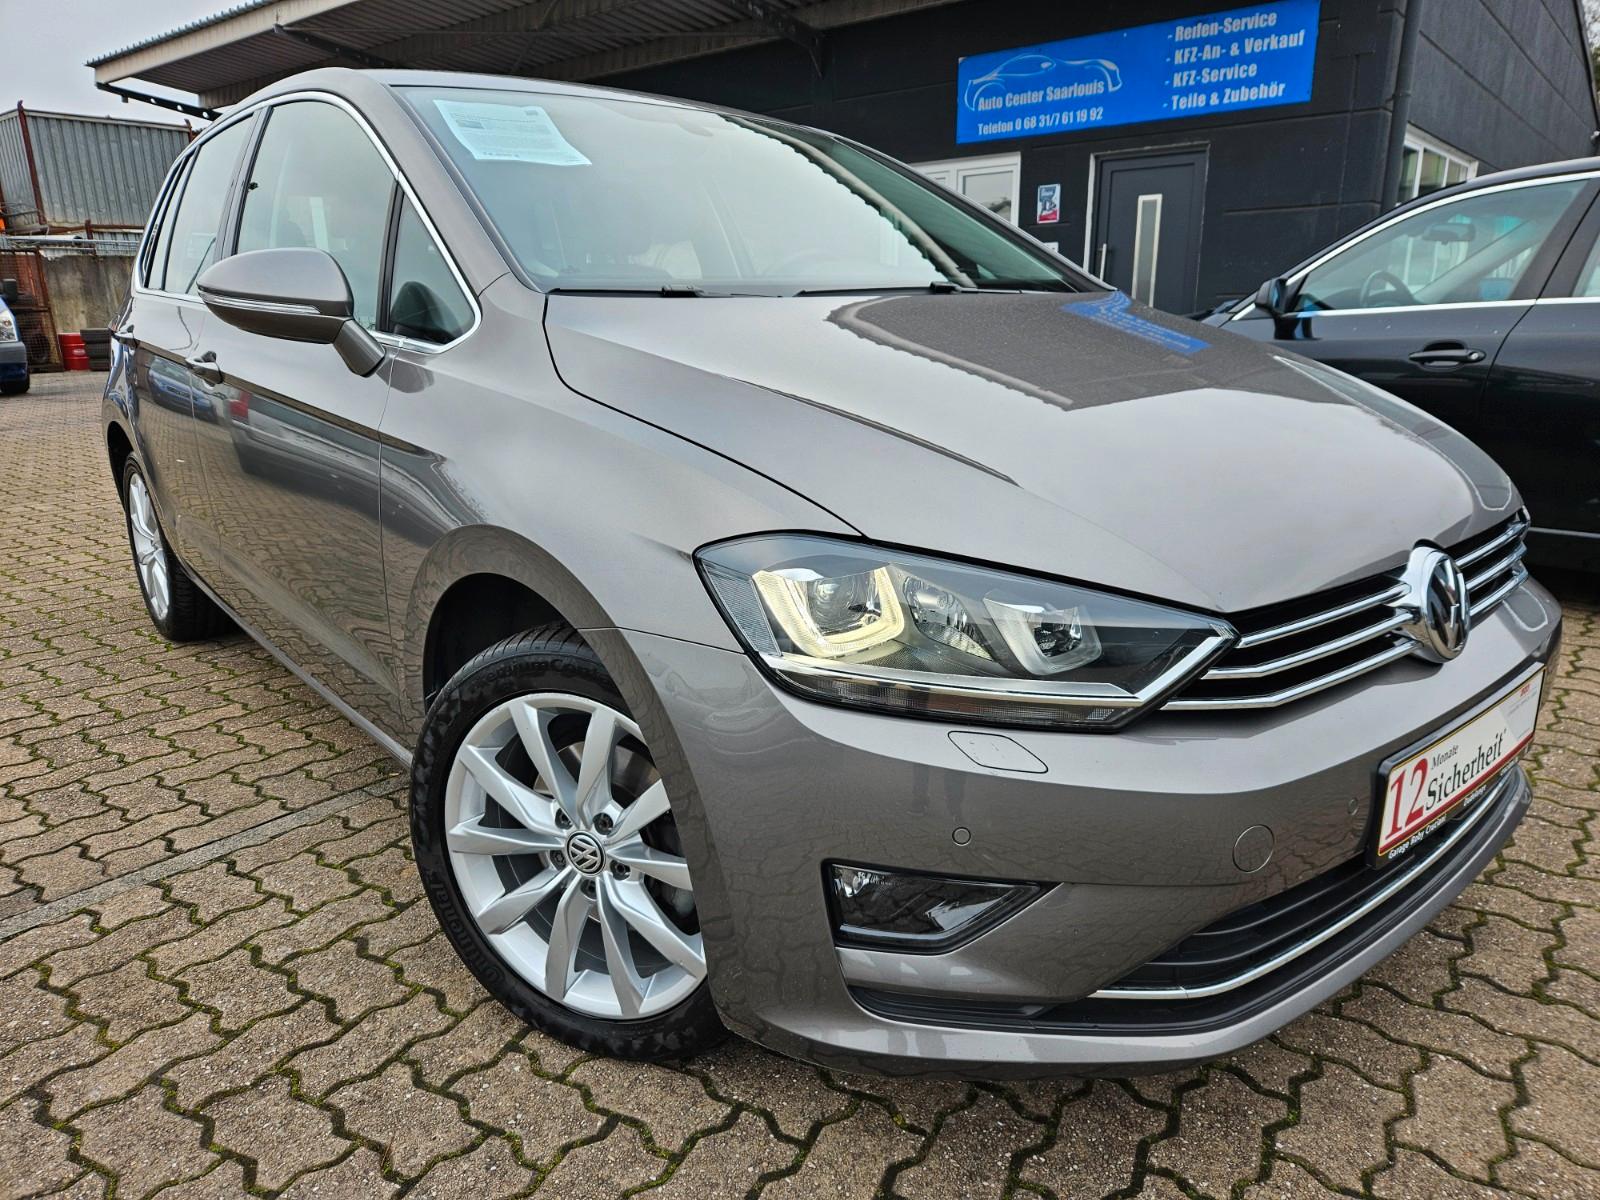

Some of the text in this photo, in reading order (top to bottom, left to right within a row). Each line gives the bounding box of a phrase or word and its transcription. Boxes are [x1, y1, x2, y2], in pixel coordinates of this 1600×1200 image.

[1175, 12, 1277, 42] Reifen-Service
[1174, 29, 1305, 65] KFZ-An- & Verkauf
[1173, 63, 1258, 88] KFZ-Service
[978, 80, 1105, 111] Auto Center Saarlouis
[1171, 81, 1286, 111] Teile & Zubehör
[978, 106, 1104, 135] Telefon 0 68 31/7 61 19 92
[1385, 733, 1504, 840] 12 Sicherheit
